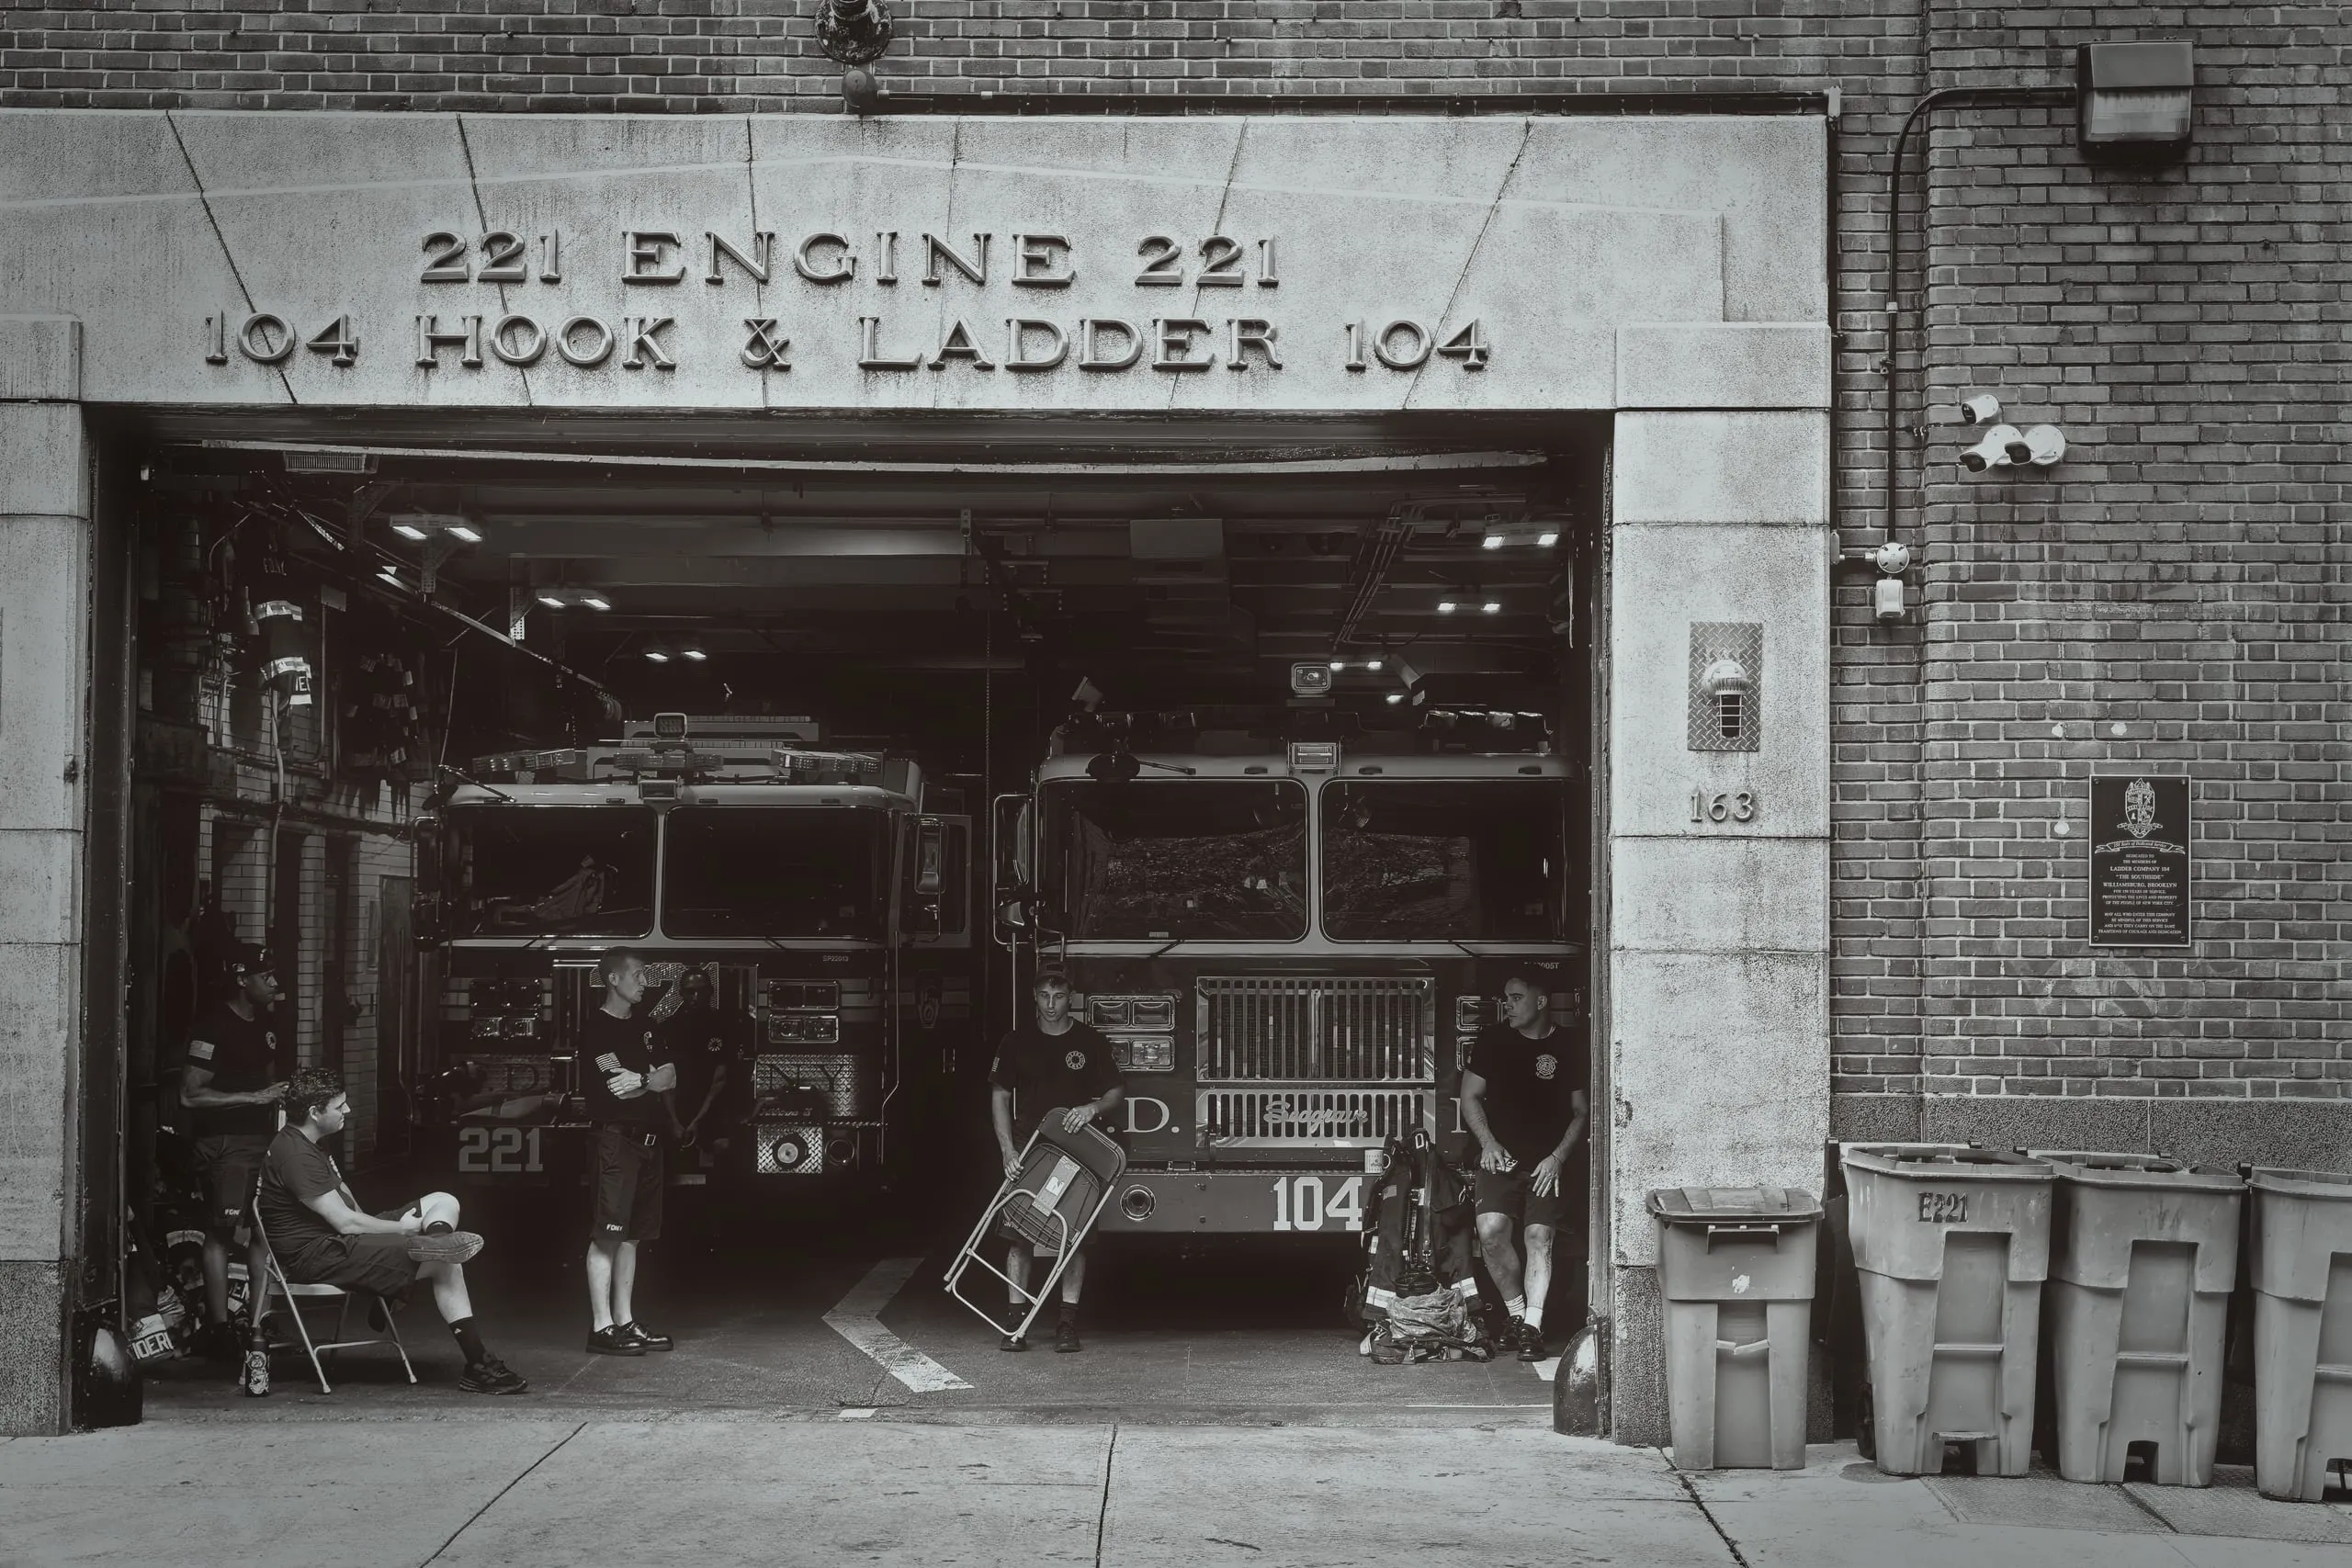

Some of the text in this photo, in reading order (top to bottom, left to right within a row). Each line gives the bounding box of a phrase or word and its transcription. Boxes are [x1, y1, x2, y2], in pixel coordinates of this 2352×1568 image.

[420, 228, 1279, 288] 221 ENGINE 221
[205, 309, 1490, 371] 104 HOOK & LADDER 104
[1690, 790, 1754, 823] 163
[458, 1126, 544, 1173] 221
[1272, 1176, 1363, 1232] 104
[1917, 1191, 1969, 1224] E221
